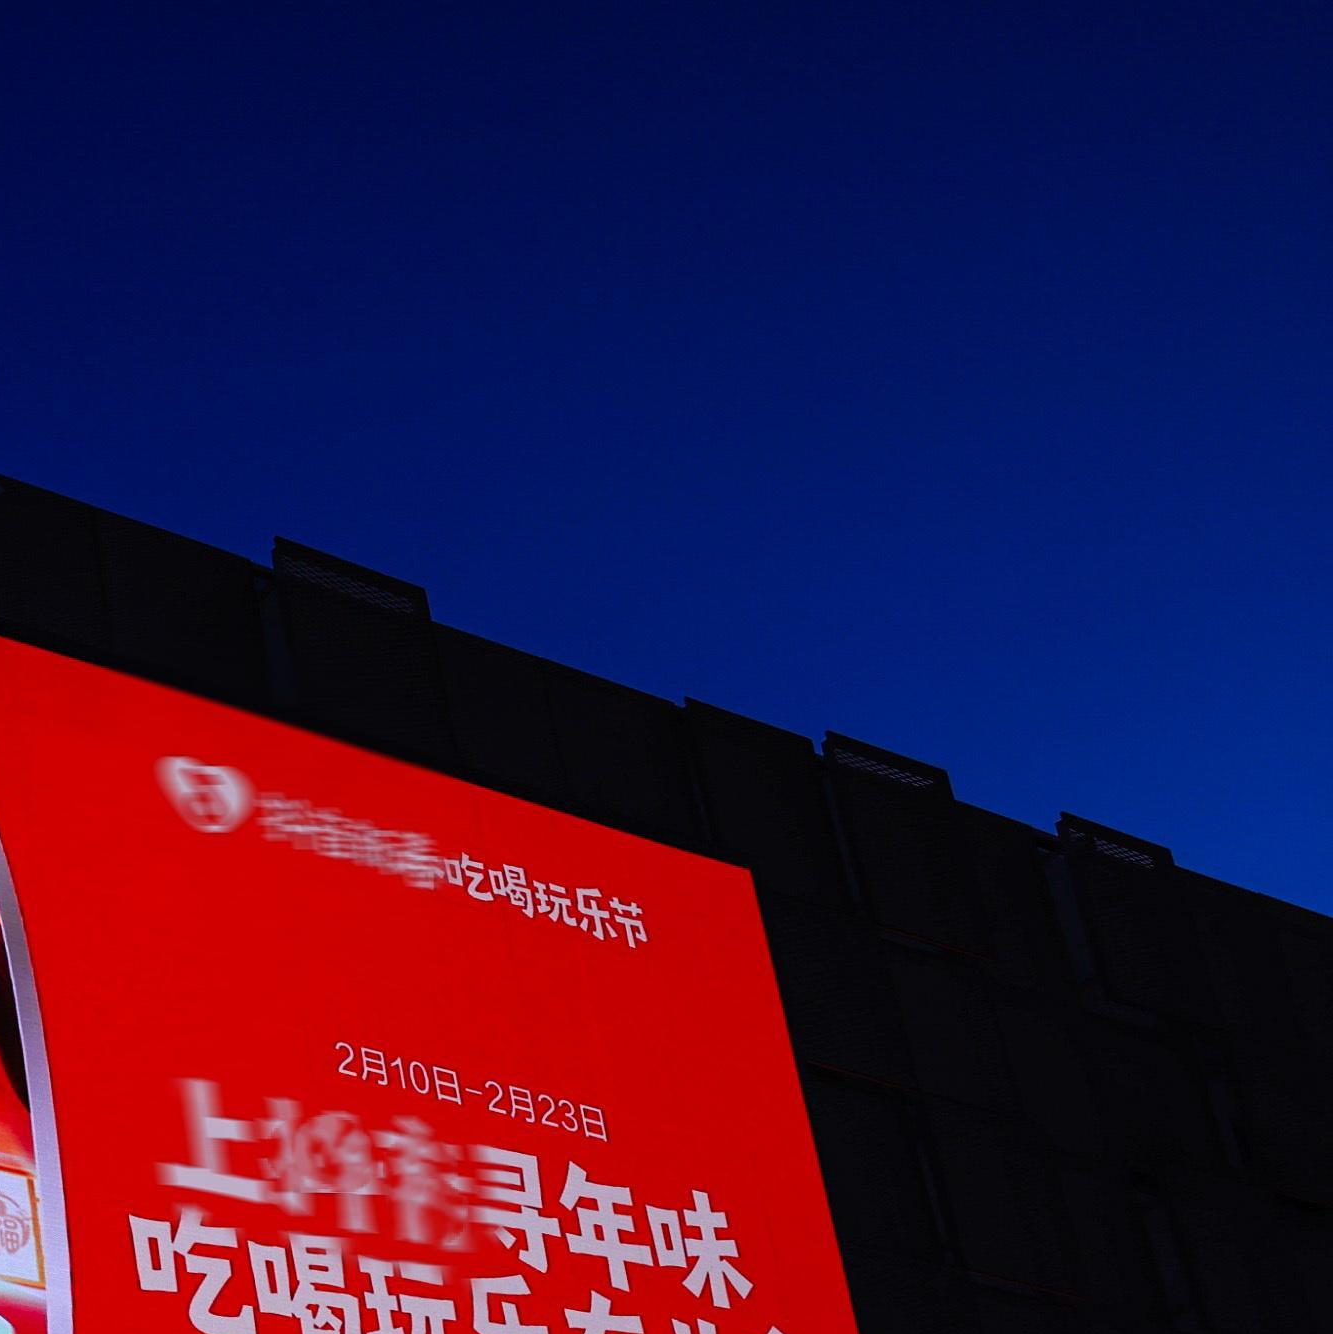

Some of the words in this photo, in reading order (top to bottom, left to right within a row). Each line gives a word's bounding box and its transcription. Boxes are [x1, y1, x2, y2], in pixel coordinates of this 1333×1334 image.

[443, 852, 649, 949] 吃喝玩乐节
[334, 1041, 609, 1143] 2月10日-2月23日
